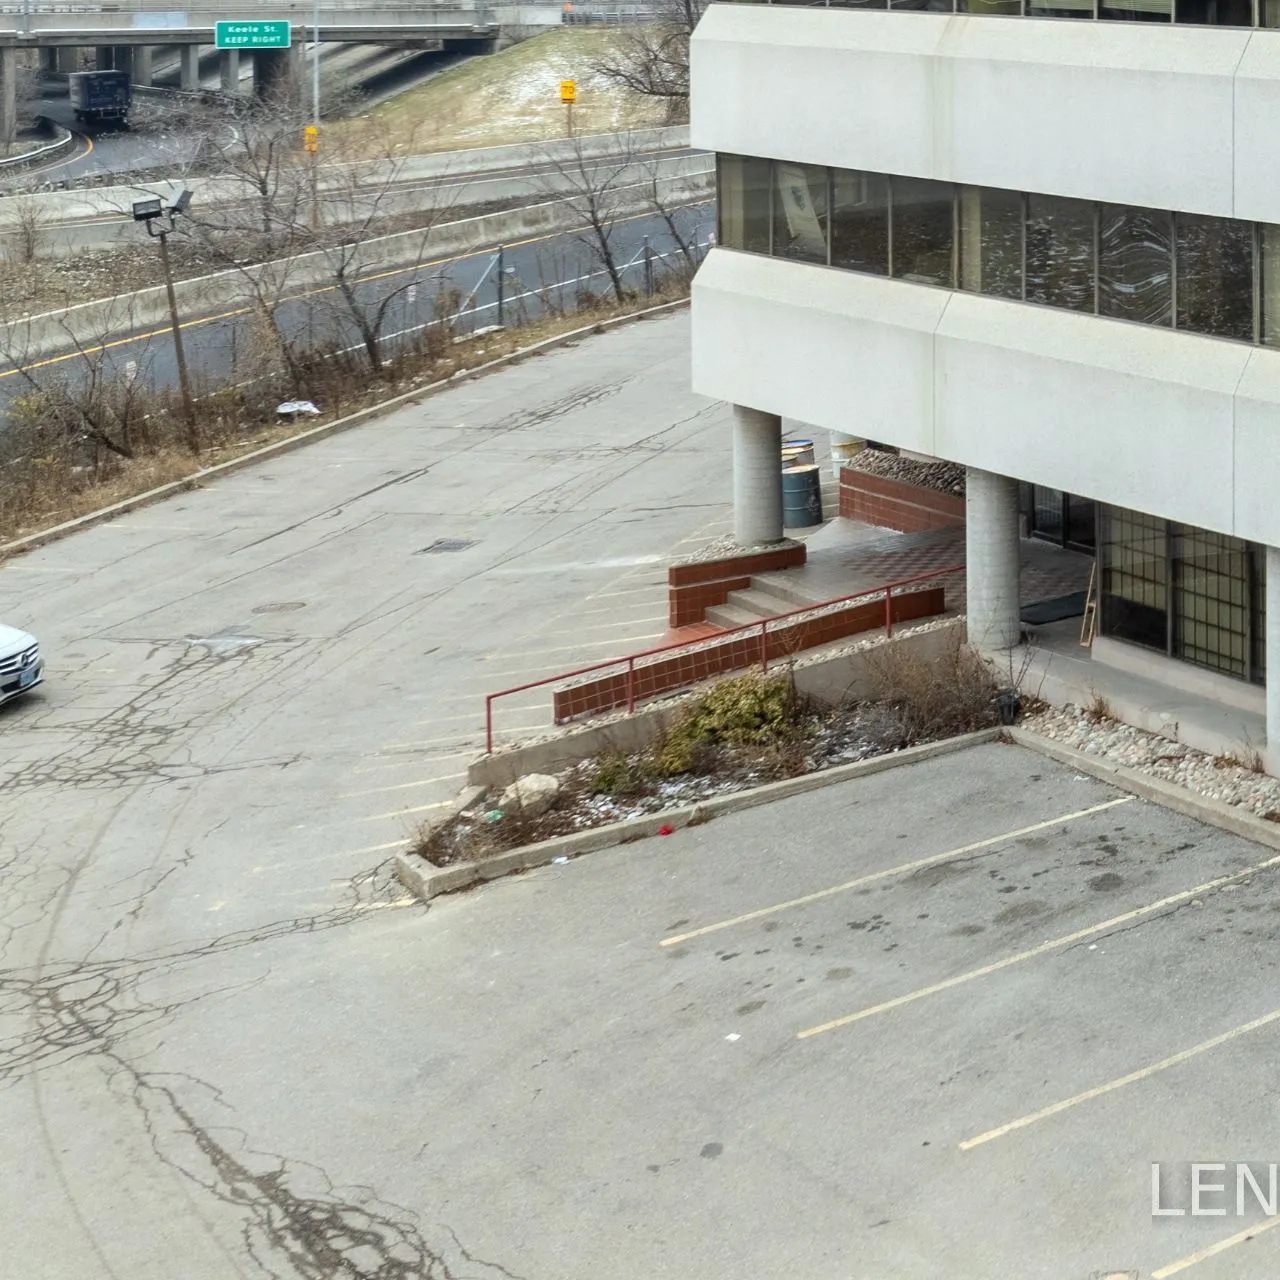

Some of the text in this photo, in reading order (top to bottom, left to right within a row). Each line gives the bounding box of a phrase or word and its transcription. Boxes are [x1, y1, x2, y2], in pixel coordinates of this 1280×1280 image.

[228, 25, 259, 33] Keele
[225, 35, 281, 44] KEEP RIGHT
